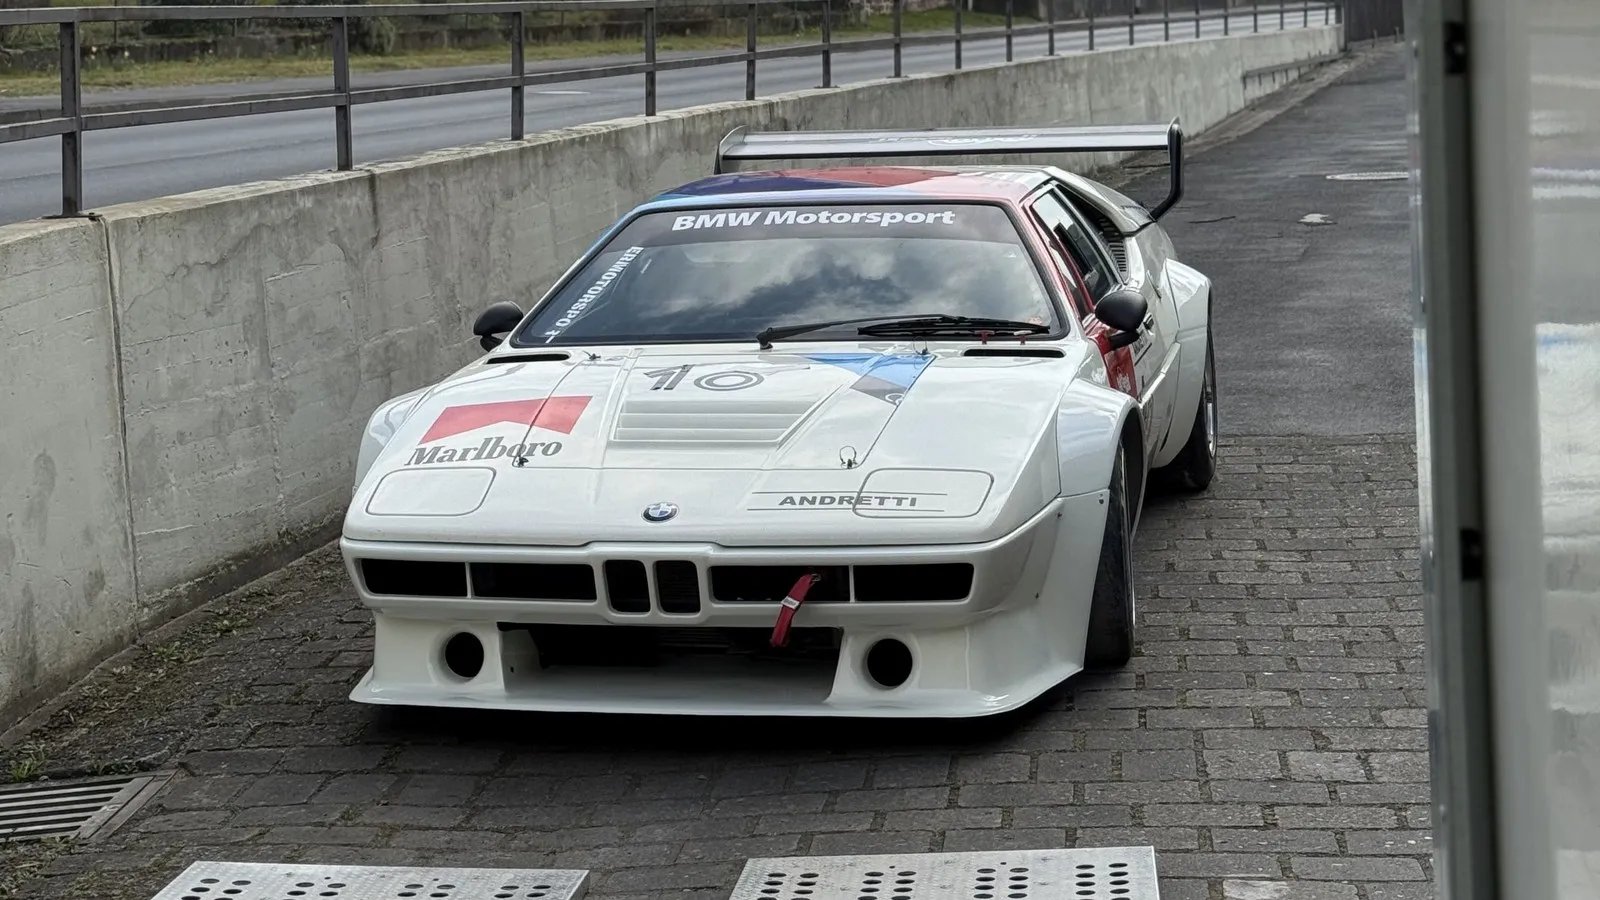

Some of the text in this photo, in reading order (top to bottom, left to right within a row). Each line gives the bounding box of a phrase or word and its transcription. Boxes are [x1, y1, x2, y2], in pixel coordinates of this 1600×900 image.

[672, 210, 956, 231] BMW Motorsport
[643, 364, 765, 391] 10
[404, 436, 562, 466] Marlboro
[778, 495, 917, 507] ANDRETTI
